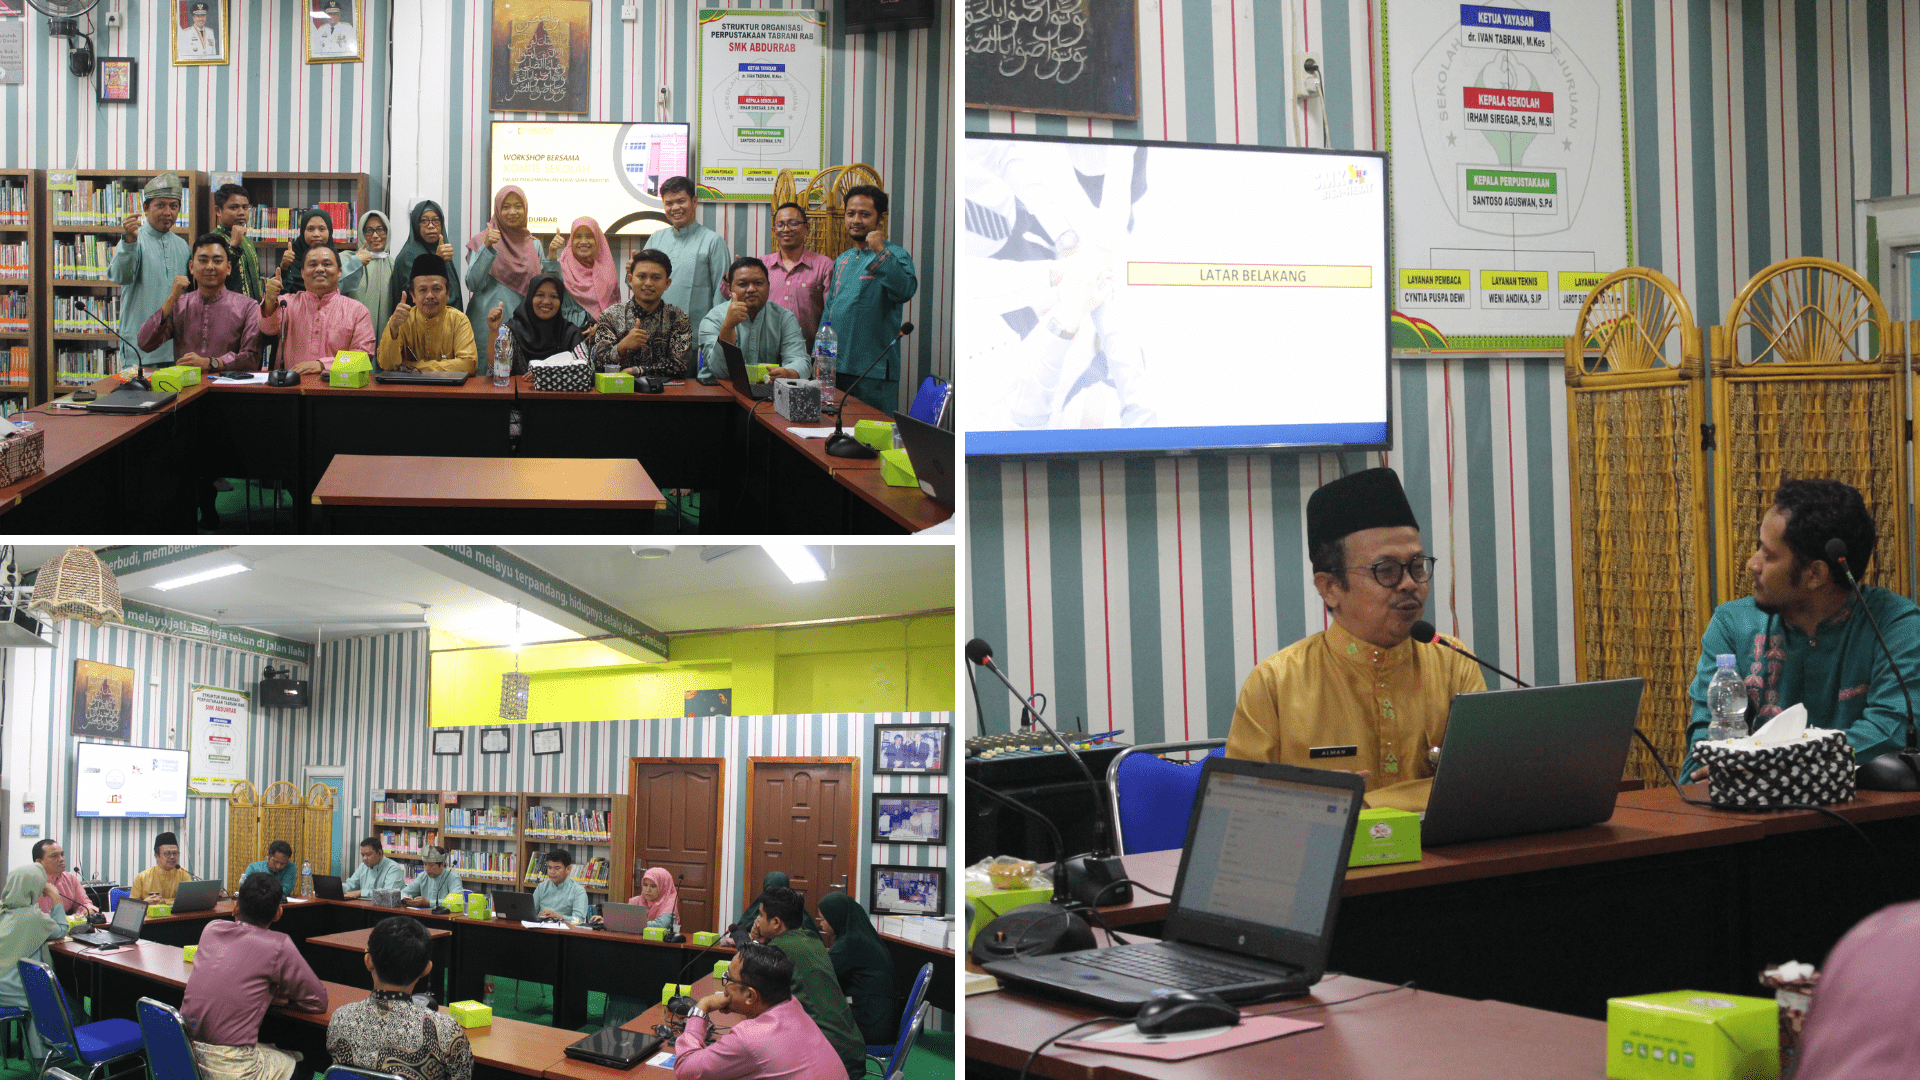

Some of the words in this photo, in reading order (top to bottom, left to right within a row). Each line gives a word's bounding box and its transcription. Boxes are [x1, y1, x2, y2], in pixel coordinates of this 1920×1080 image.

[1478, 12, 1502, 24] KETUA
[1503, 14, 1534, 27] YAYASAN
[722, 23, 759, 31] STRUKTUR
[768, 32, 798, 40] TABRANI
[1468, 32, 1476, 42] dr.
[1478, 33, 1493, 43] IVAN
[1495, 34, 1525, 47] TABRANI,
[1526, 37, 1545, 47] M.Kes
[729, 42, 747, 52] SMK
[750, 43, 796, 53] ABDURRAB
[1437, 38, 1462, 122] SEKOLAH
[1551, 46, 1579, 129] EJURUAN
[1478, 94, 1506, 107] KEPALA
[1507, 96, 1540, 109] SEKOLAH
[1467, 112, 1489, 123] IRHAM
[1490, 114, 1520, 127] SIREGAR,
[1521, 115, 1537, 127] S.Pd,
[1539, 116, 1552, 127] M.Si
[503, 164, 541, 173] KOMITE
[544, 164, 590, 174] SEKOLAH
[1473, 175, 1499, 186] KEPALA
[1499, 176, 1550, 188] PERPUSTAKAAN
[1472, 195, 1503, 206] SANTOSO
[1504, 196, 1538, 209] AGUSWAN,
[1539, 198, 1553, 208] S.Pd
[1200, 269, 1239, 281] LATAR
[1243, 269, 1306, 283] BELAKANG
[1407, 275, 1434, 285] LAYANAN
[1435, 276, 1462, 285] PEMBACA
[1491, 277, 1517, 286] LAYANAN
[1518, 277, 1538, 286] TEKNIS
[1404, 292, 1427, 302] CYNTIA
[1429, 293, 1449, 303] PUSPA
[1450, 293, 1465, 303] DEWI
[1489, 293, 1504, 303] WENI
[1505, 294, 1530, 305] ANDIKA,
[106, 550, 141, 571] erbudi,
[475, 550, 513, 578] melayu
[515, 567, 568, 607] terpandang,
[569, 593, 602, 622] hidupnya
[127, 610, 167, 627] melayu
[168, 617, 189, 631] jati,
[229, 633, 255, 646] tekun
[256, 638, 265, 648] di
[265, 640, 286, 653] jalan
[288, 644, 305, 657] ilahi
